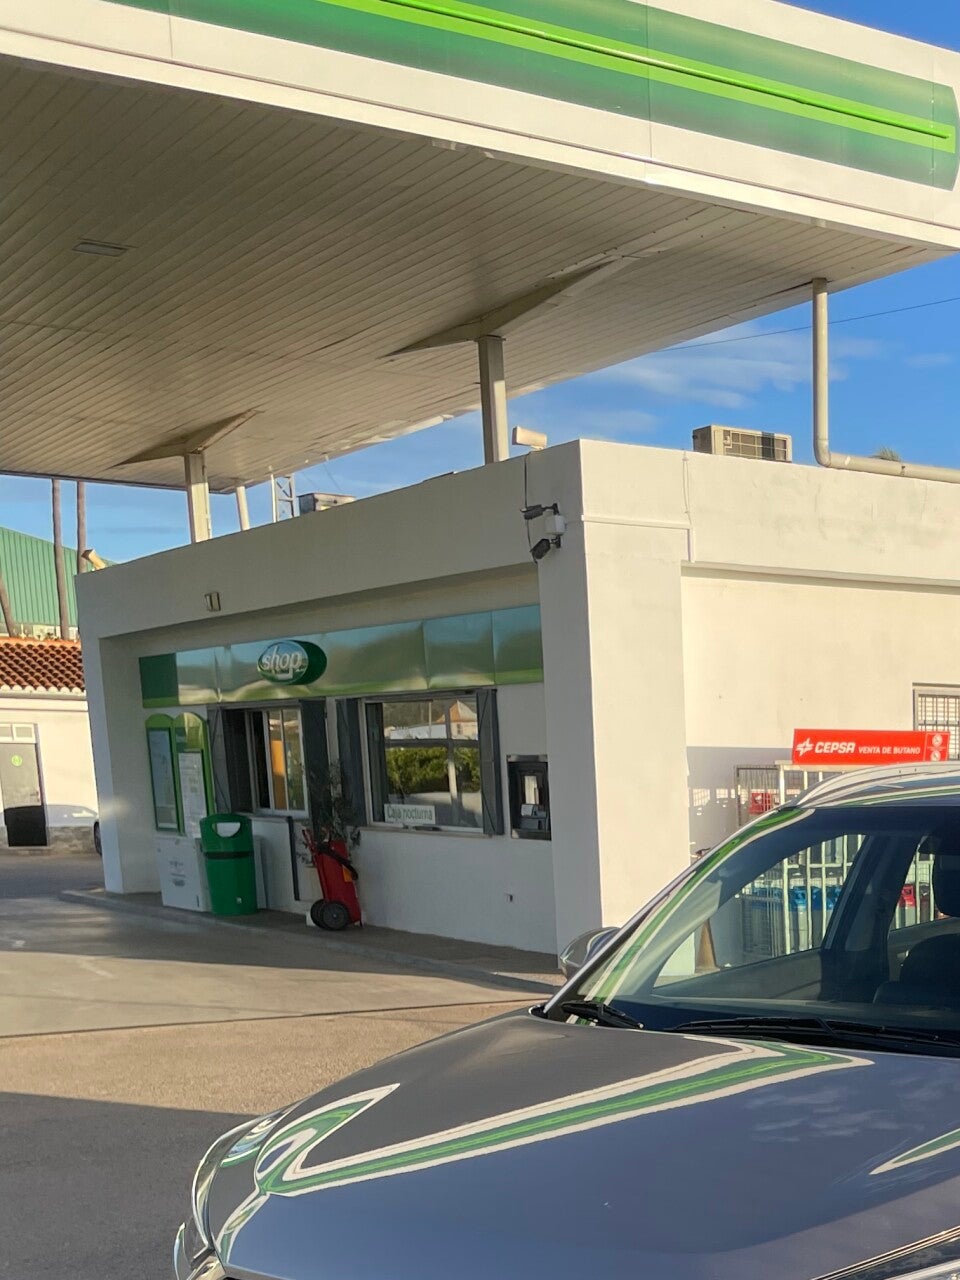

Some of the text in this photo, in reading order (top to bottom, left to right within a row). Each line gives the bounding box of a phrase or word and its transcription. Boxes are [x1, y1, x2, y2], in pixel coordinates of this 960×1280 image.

[261, 645, 303, 679] shop
[815, 741, 856, 754] CEPSA
[858, 746, 881, 755] VENTA
[882, 746, 892, 755] DE
[893, 746, 921, 755] BUTANO
